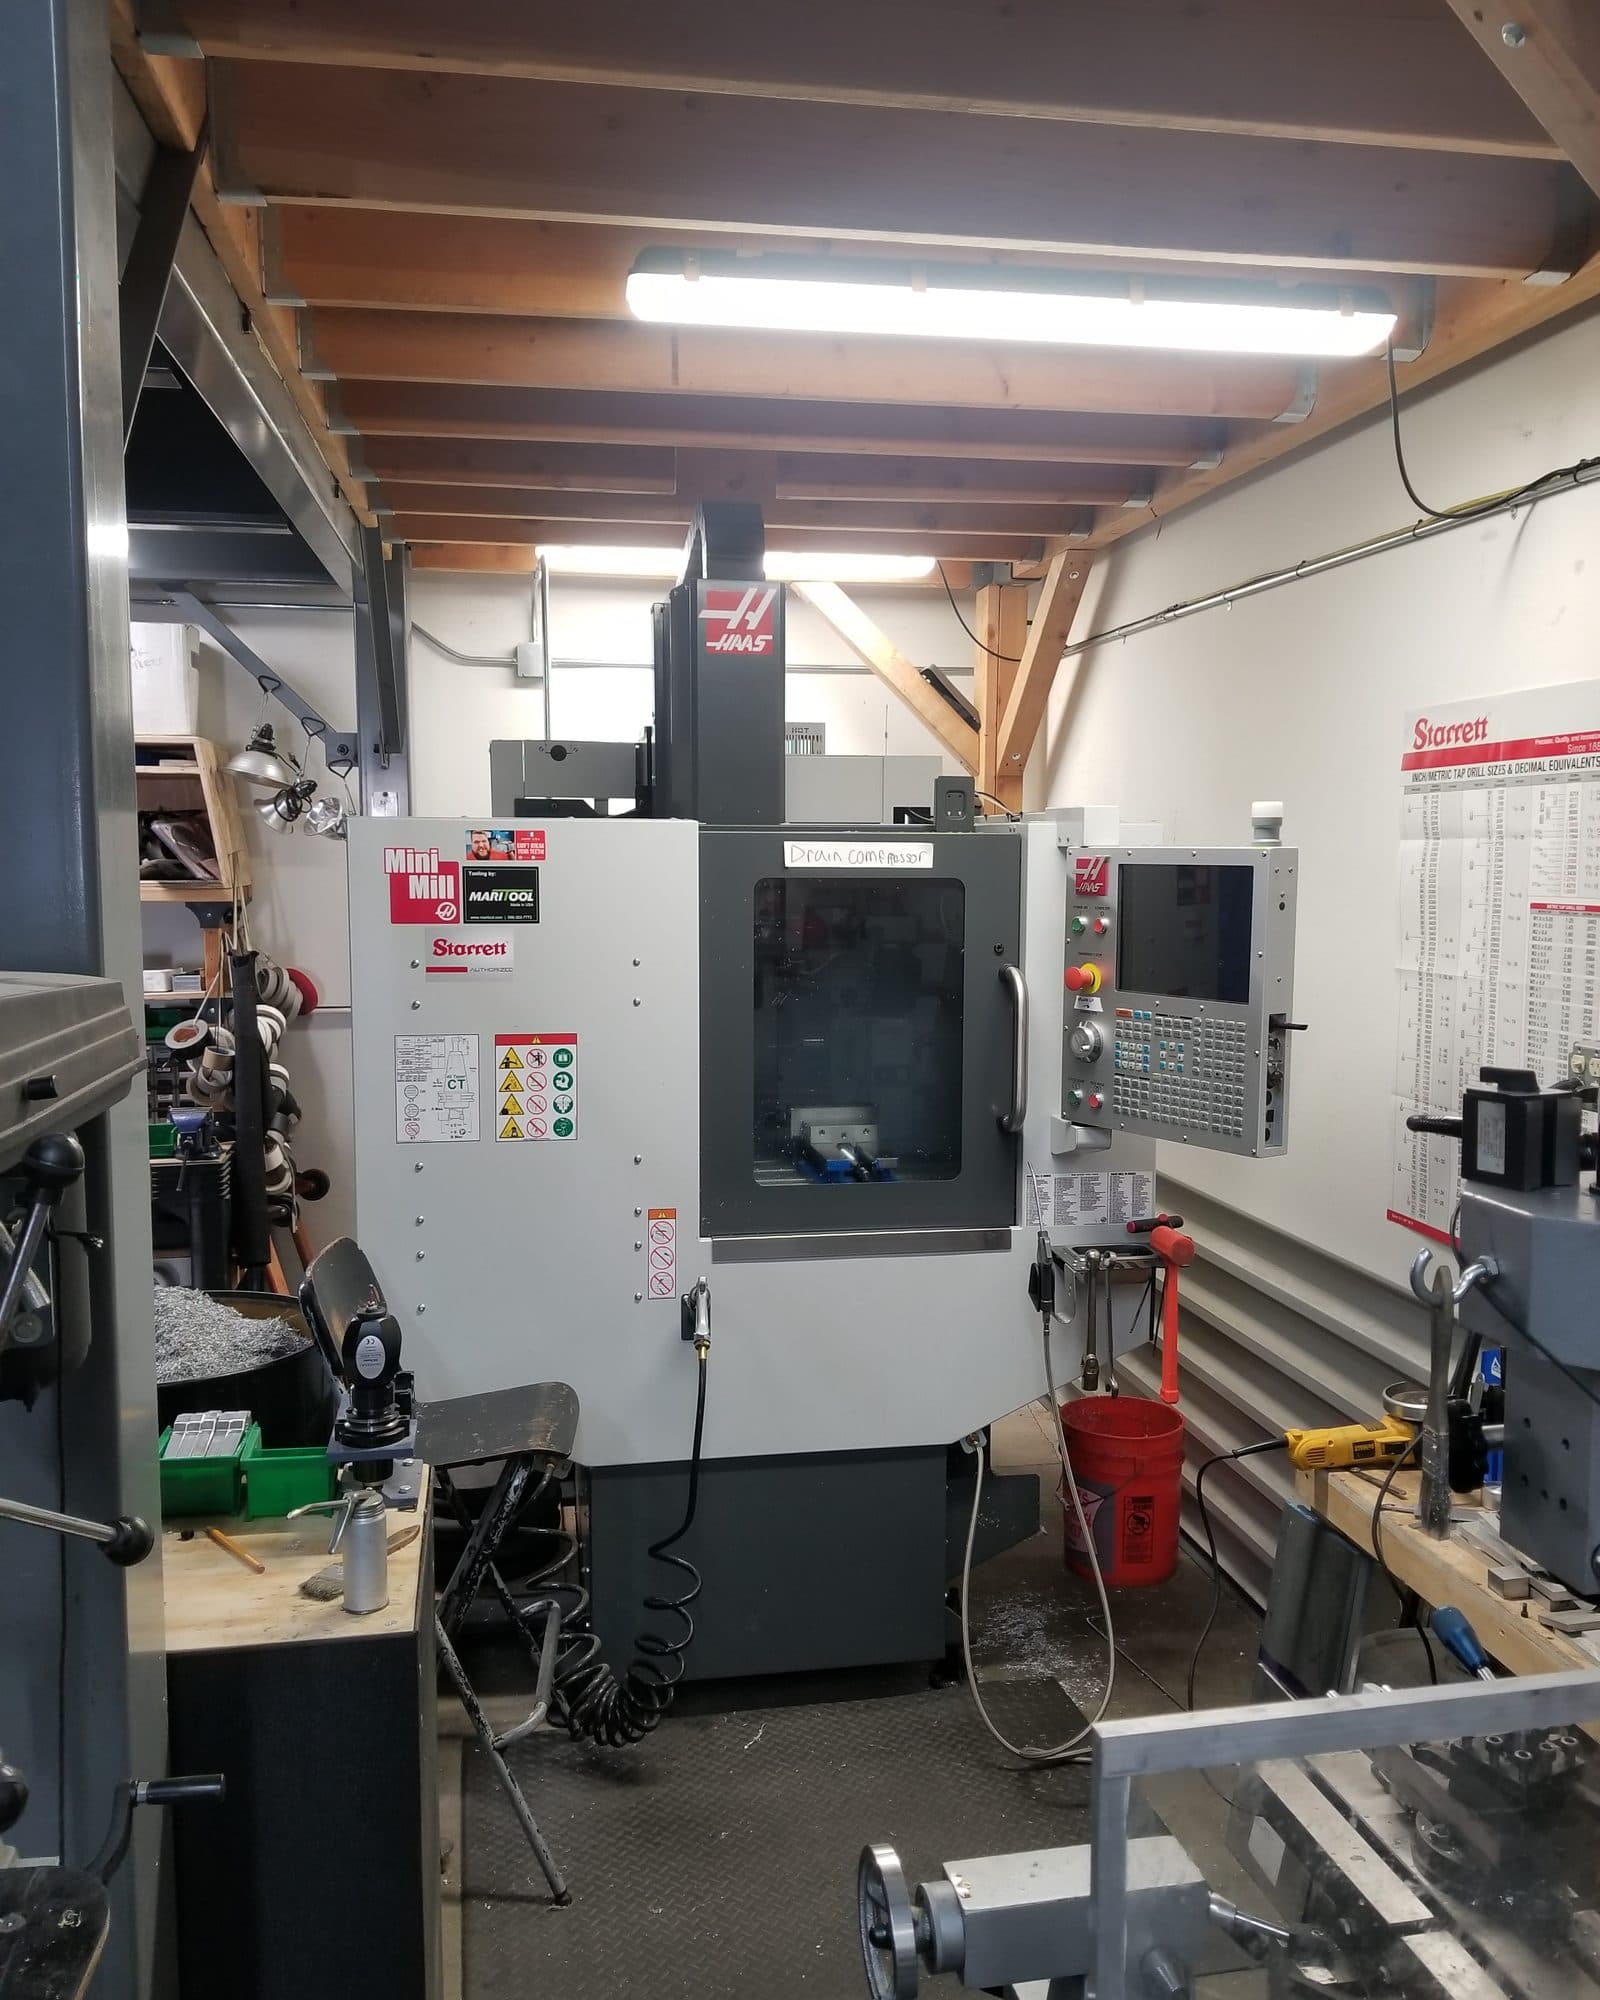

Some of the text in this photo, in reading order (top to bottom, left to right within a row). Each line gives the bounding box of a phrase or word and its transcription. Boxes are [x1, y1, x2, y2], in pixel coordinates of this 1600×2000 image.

[706, 634, 773, 652] HAAS
[1413, 715, 1489, 750] Starrett
[1568, 744, 1587, 753] Since
[1454, 767, 1467, 779] TAP
[1467, 765, 1486, 778] DRILL
[1487, 764, 1507, 777] SIZES
[1507, 763, 1513, 774] &
[1514, 759, 1547, 775] DECIMAL
[1549, 755, 1600, 772] EQUIVALENTS
[384, 848, 439, 874] Mini
[790, 844, 842, 863] Drain
[408, 874, 455, 900] Mill
[468, 889, 534, 902] MARITOOL
[432, 938, 507, 957] Starrett
[447, 1079, 466, 1090] CT
